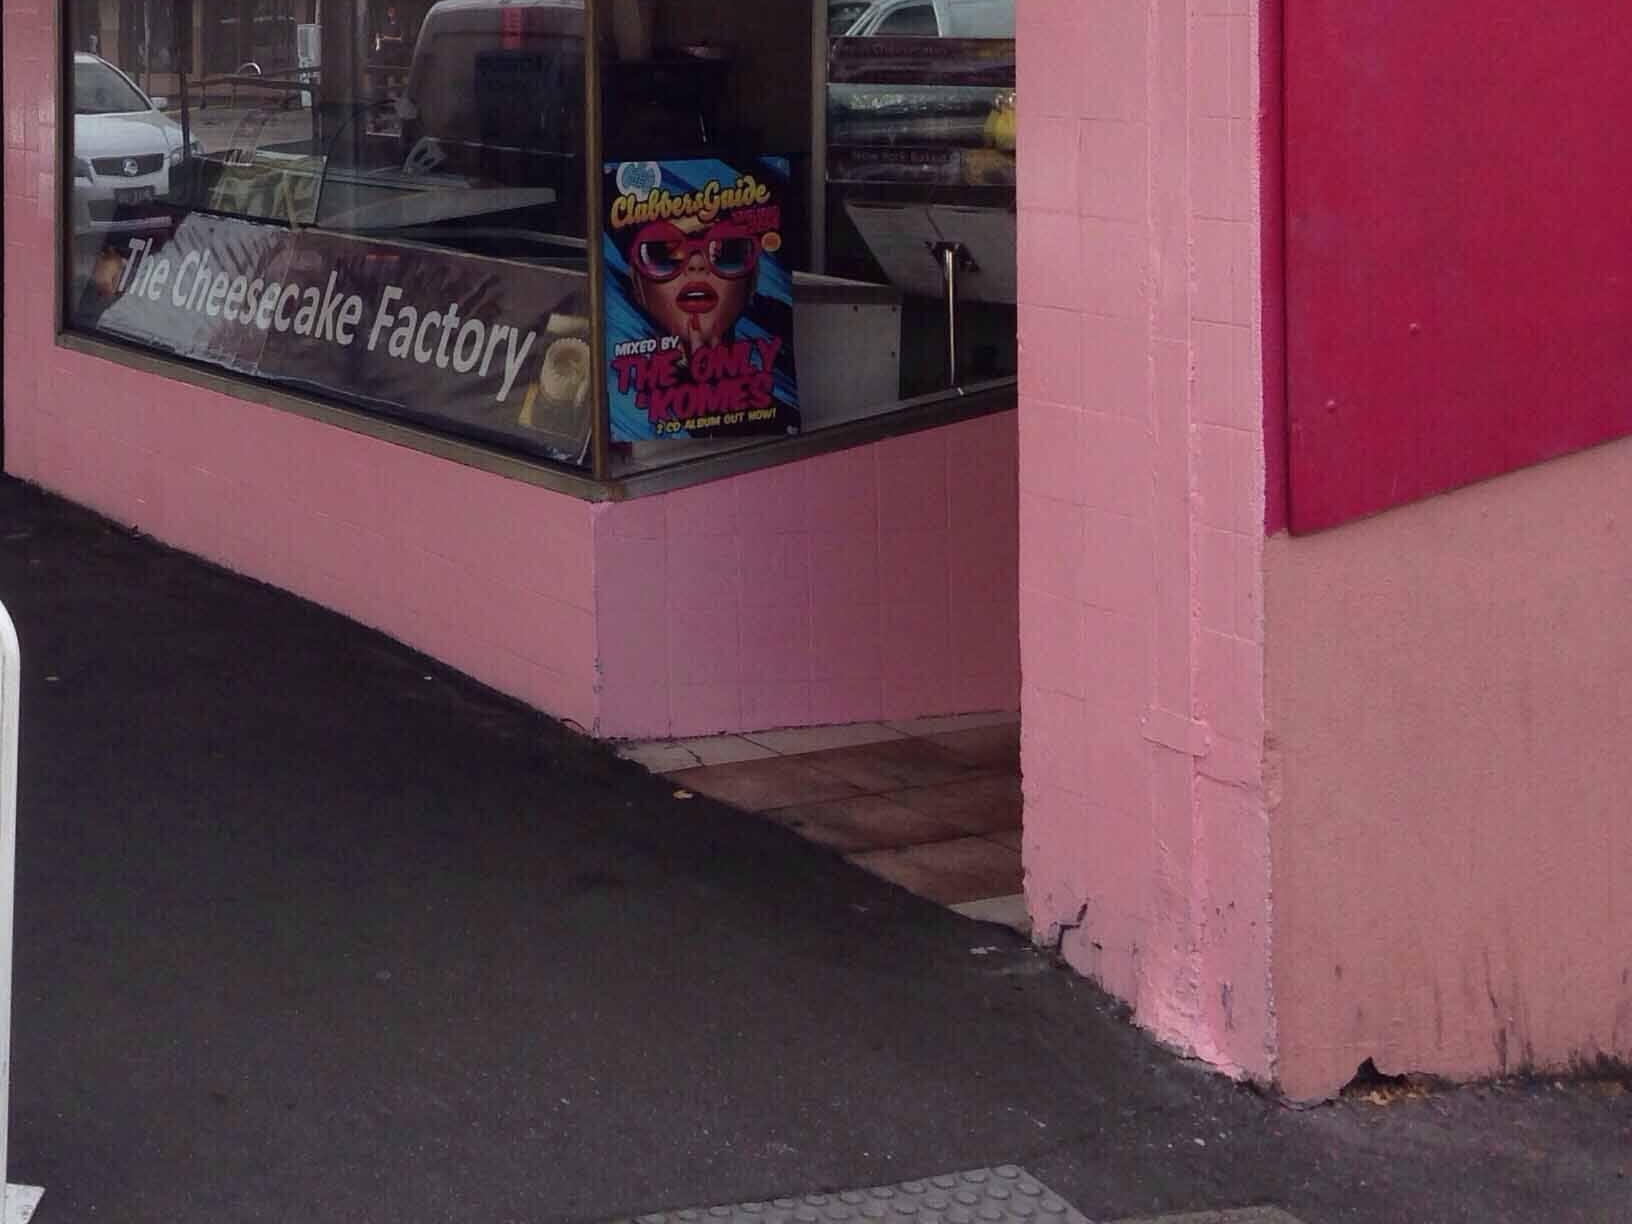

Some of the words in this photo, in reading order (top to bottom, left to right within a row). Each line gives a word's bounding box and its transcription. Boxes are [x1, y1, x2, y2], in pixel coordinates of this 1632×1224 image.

[117, 237, 168, 301] The
[172, 249, 364, 345] Cheesecake
[368, 286, 536, 402] Factory
[615, 338, 657, 357] MIXED
[661, 335, 679, 351] BY
[611, 349, 682, 393] THE
